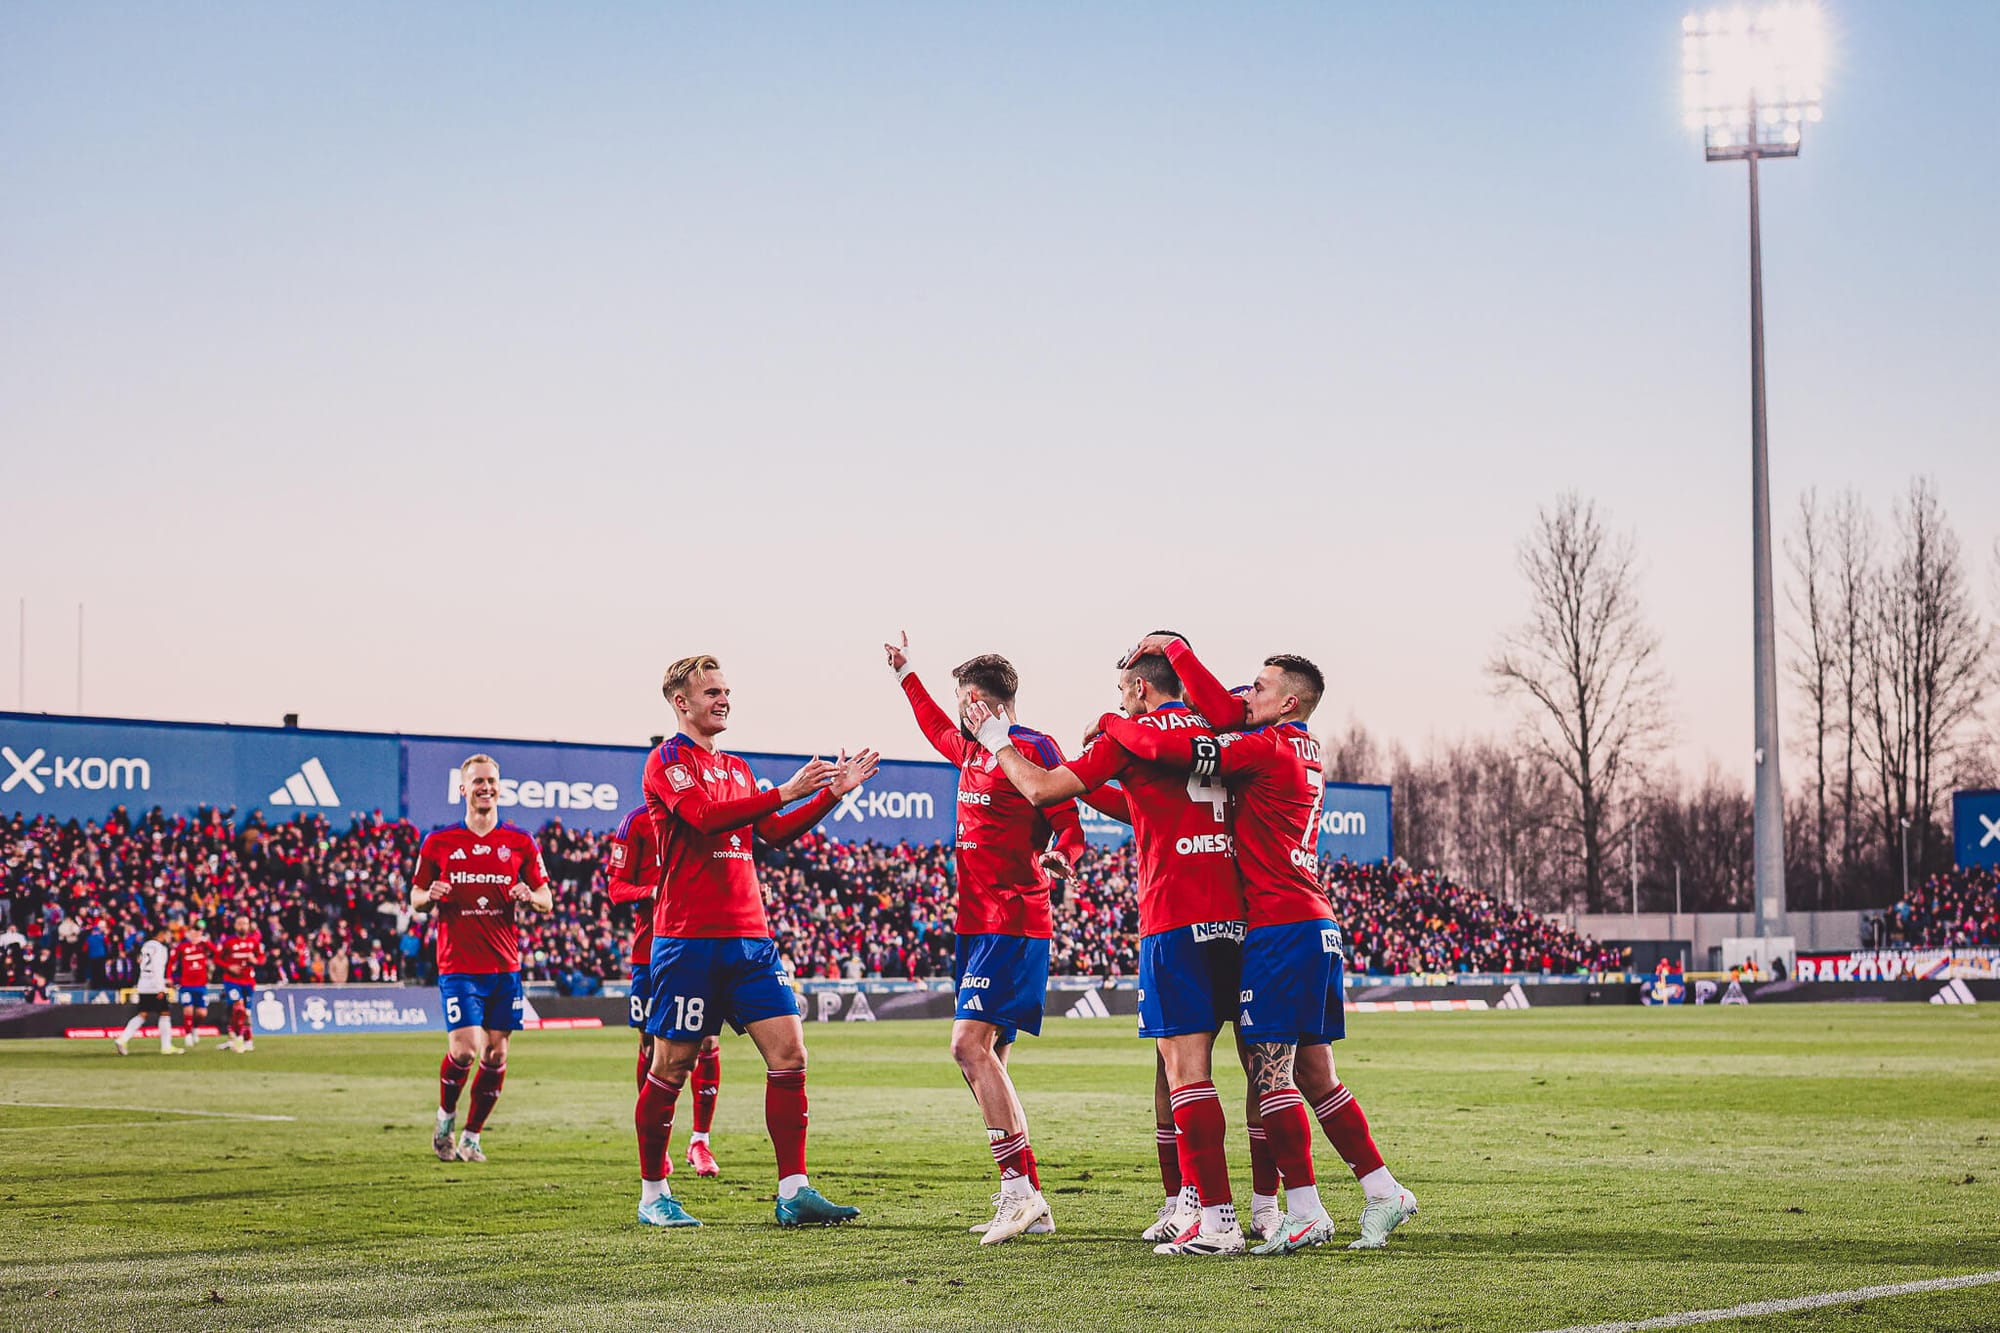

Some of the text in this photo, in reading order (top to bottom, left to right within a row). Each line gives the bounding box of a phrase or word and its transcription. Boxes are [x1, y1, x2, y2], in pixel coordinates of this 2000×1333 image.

[448, 768, 619, 811] sense
[1186, 770, 1228, 822] 4
[1302, 768, 1323, 851] 7
[450, 871, 512, 885] Hisense
[446, 996, 461, 1024] 5
[674, 995, 705, 1031] 18
